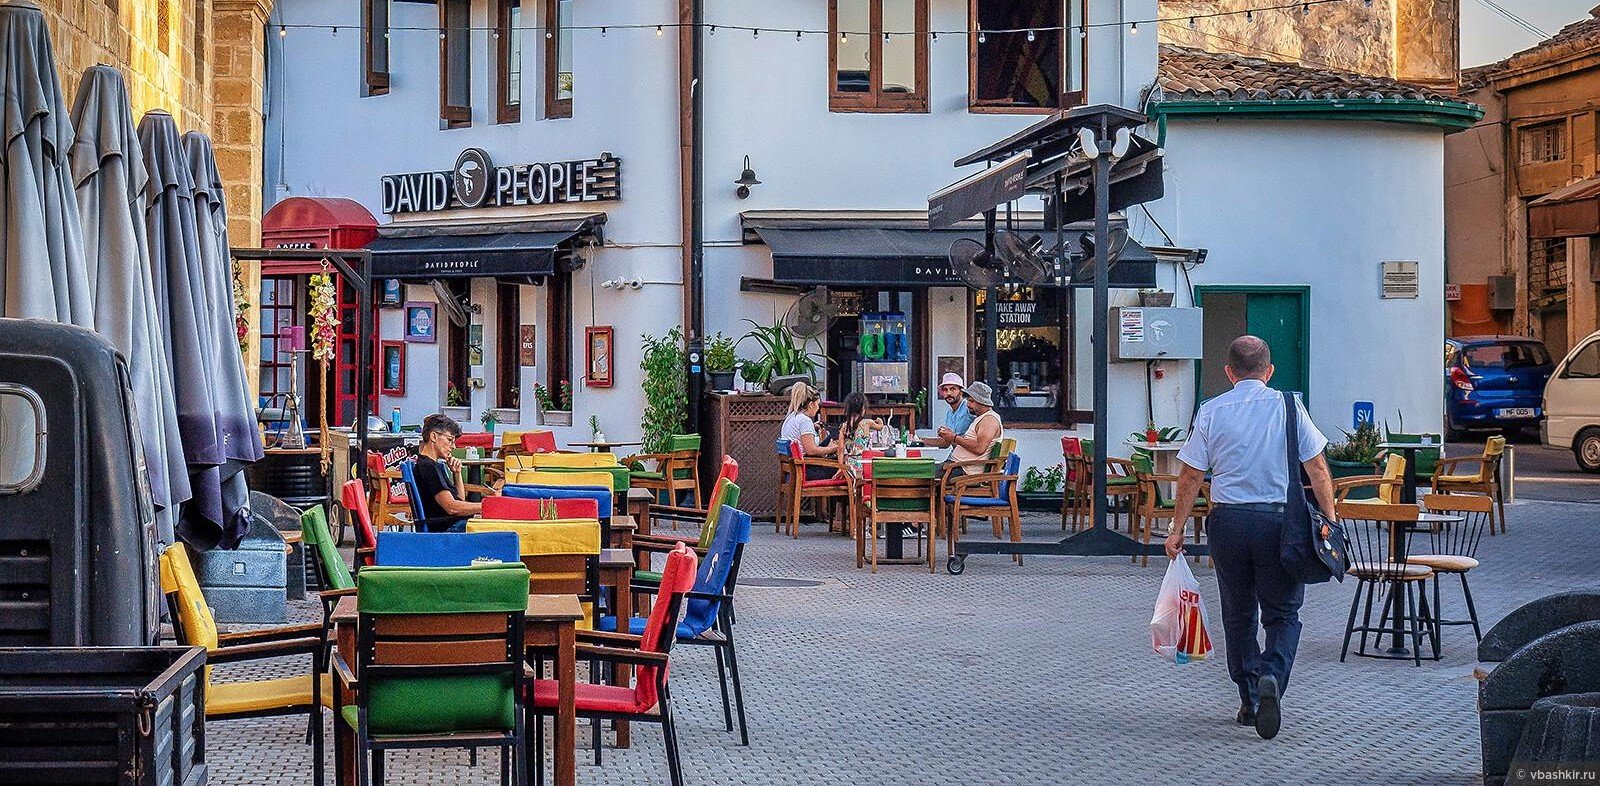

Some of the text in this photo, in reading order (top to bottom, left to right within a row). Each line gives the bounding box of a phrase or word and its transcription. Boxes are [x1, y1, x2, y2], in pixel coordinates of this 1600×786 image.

[381, 160, 598, 213] DAVID PEOPLE
[995, 303, 1036, 313] TAKE AWAY
[1000, 313, 1031, 323] STATION
[1357, 409, 1371, 422] SV
[384, 447, 407, 465] ukta
